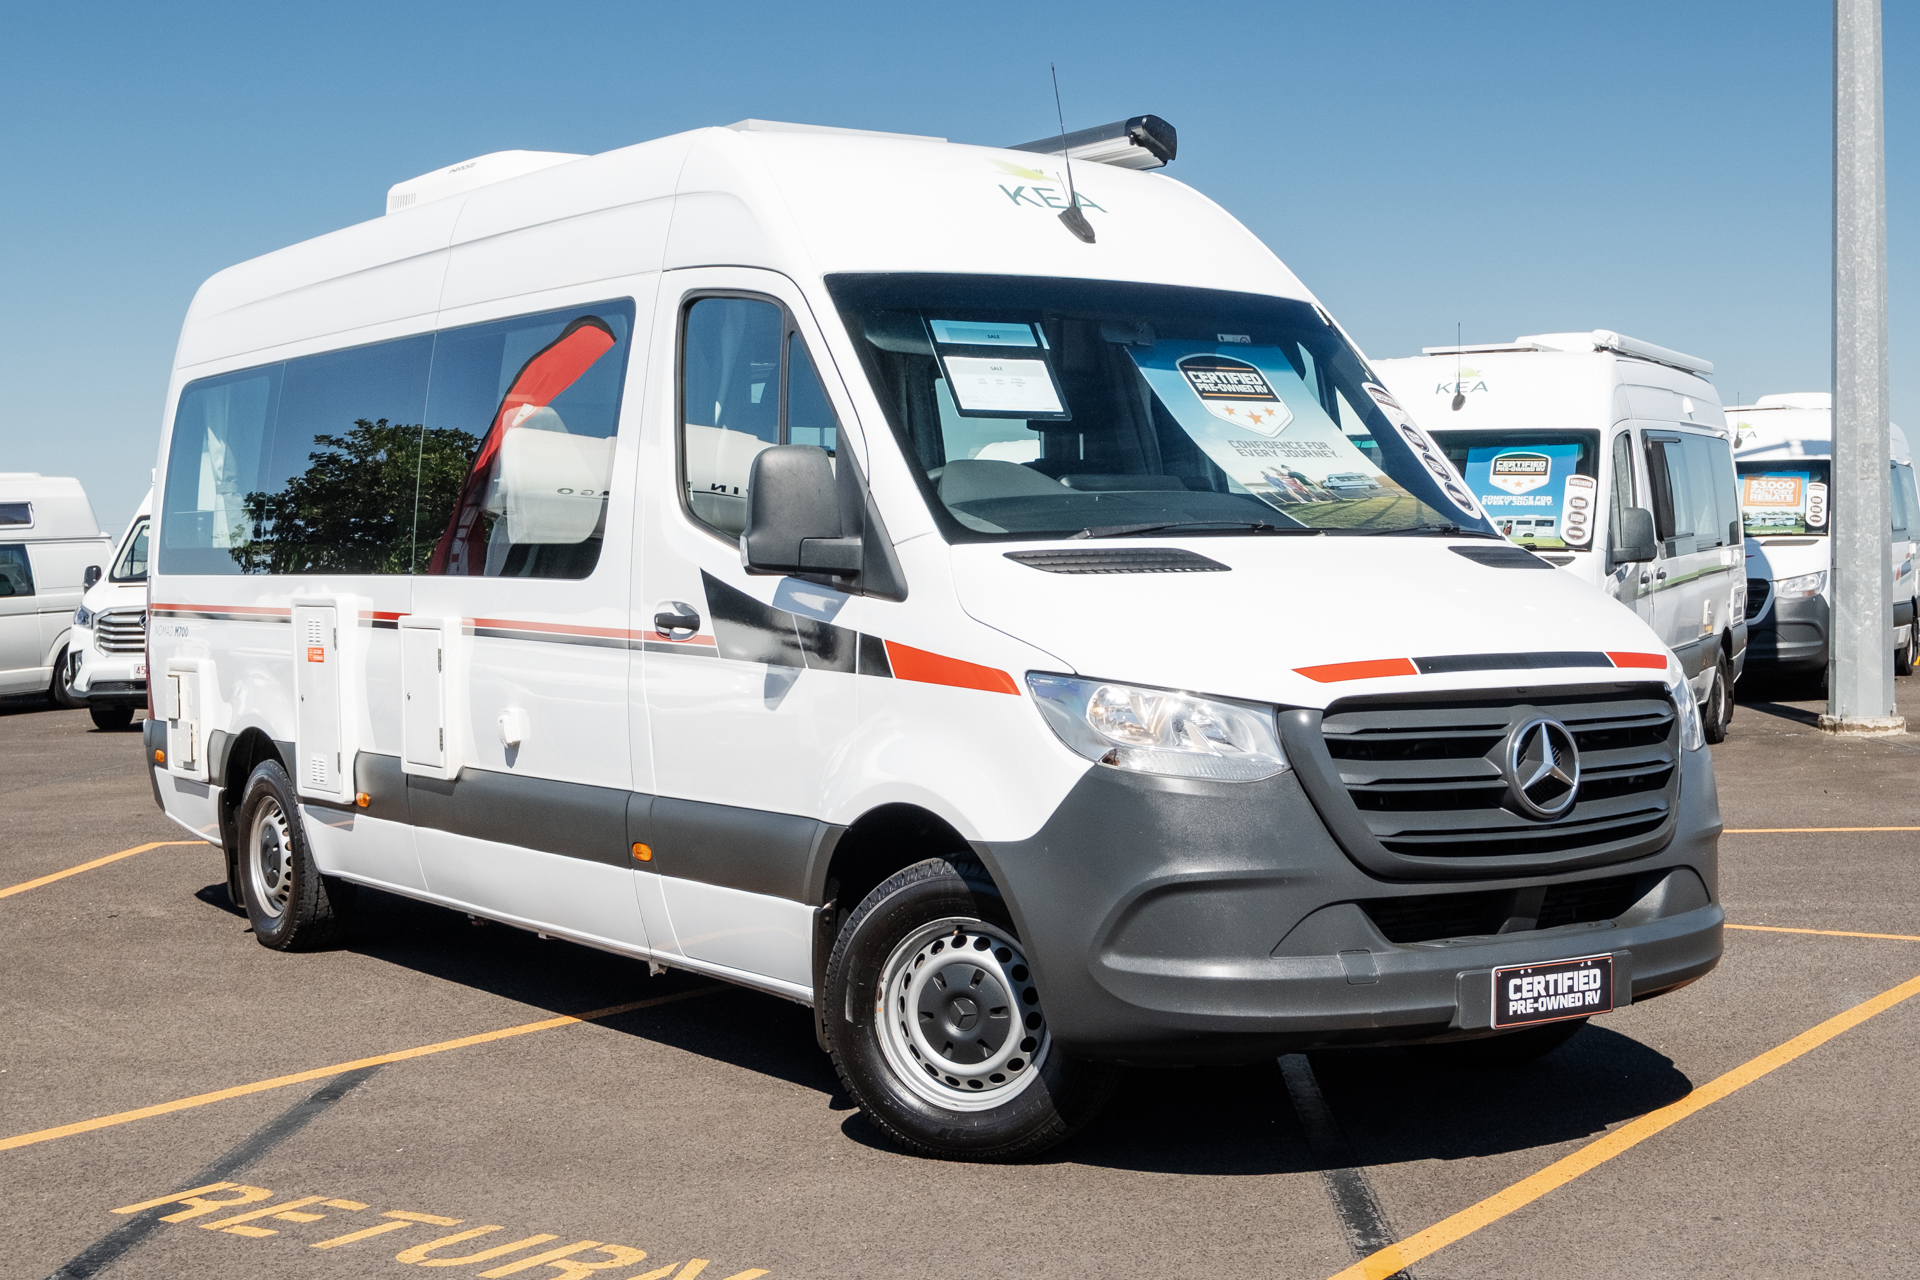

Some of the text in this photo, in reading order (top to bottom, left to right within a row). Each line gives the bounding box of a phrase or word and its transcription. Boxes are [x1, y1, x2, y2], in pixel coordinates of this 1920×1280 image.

[998, 184, 1108, 213] KEA
[1187, 371, 1263, 384] CERTIFIED
[1196, 383, 1269, 394] PRE-OWNED RV
[1435, 380, 1488, 395] KEA
[1227, 440, 1329, 450] CONFIDENCE FOR
[1235, 448, 1343, 459] EVERY JOURNEY.
[1750, 494, 1794, 502] REBATE
[154, 625, 189, 637] NOMAD M700
[1509, 969, 1601, 1000] CERTIFIED
[1509, 990, 1601, 1015] PRE-OWNED RV
